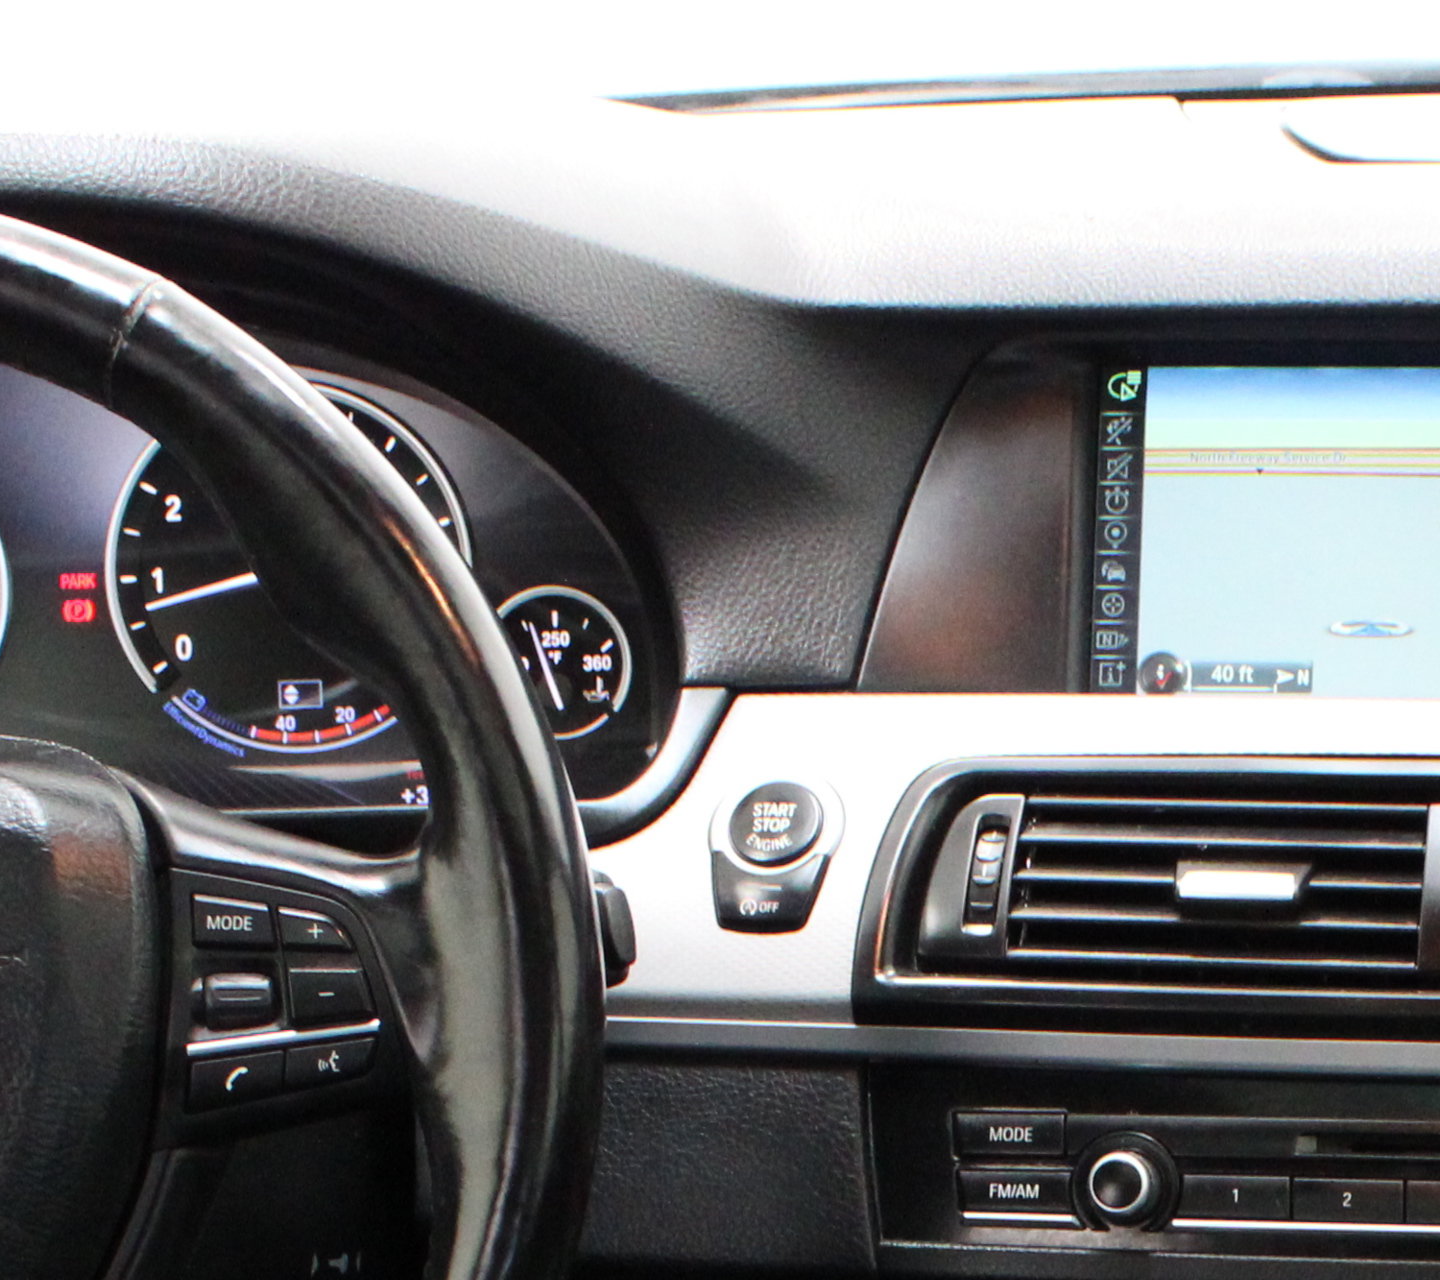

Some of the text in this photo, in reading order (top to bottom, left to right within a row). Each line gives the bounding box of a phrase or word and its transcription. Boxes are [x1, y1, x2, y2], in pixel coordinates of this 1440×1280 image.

[1190, 451, 1224, 463] North
[1284, 451, 1330, 464] Service
[164, 494, 183, 523] 2
[59, 572, 98, 590] PARK
[150, 566, 164, 594] 1
[541, 630, 571, 648] 250
[175, 634, 193, 662] 0
[582, 654, 612, 672] 360
[1211, 665, 1254, 684] 40 ft
[334, 705, 356, 723] 20
[275, 715, 296, 732] 40
[752, 802, 798, 819] START
[752, 818, 791, 833] STOP
[745, 835, 793, 852] ENGINE
[759, 902, 779, 914] OFF
[206, 915, 253, 932] MODE
[989, 1126, 1033, 1143] MODE
[989, 1183, 1040, 1201] FM/AM
[1232, 1189, 1239, 1203] 1
[1342, 1192, 1352, 1208] 2
